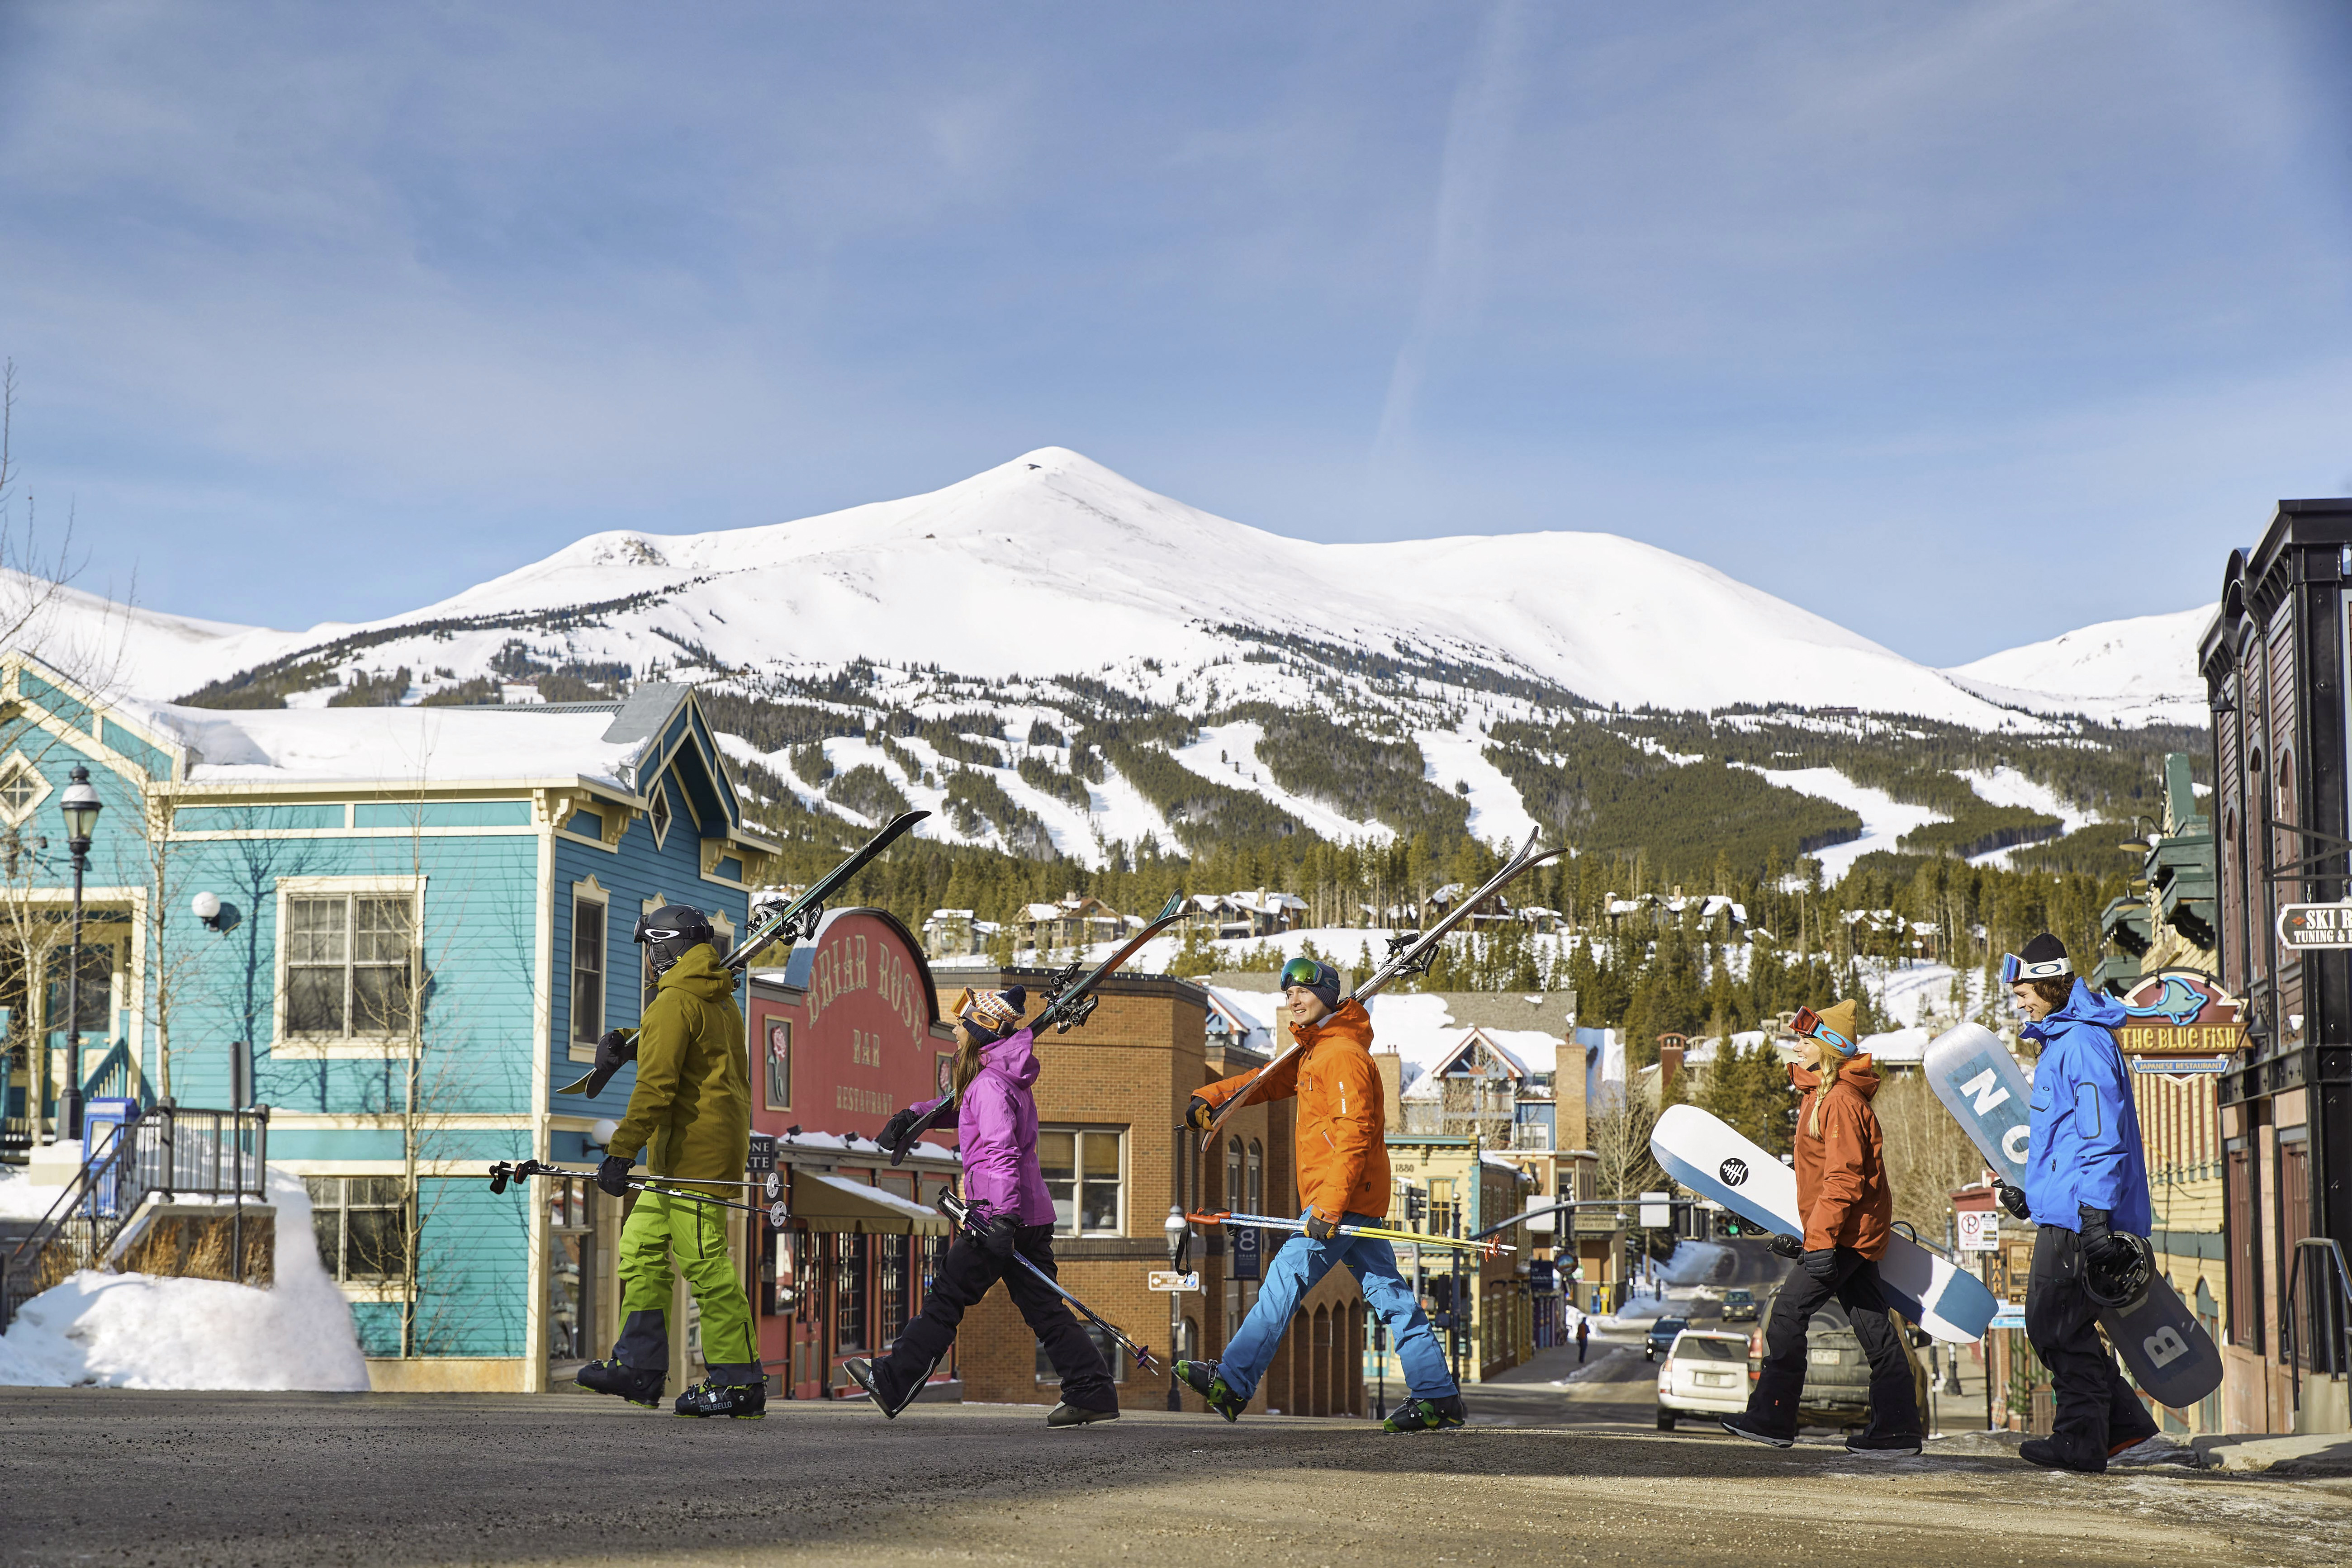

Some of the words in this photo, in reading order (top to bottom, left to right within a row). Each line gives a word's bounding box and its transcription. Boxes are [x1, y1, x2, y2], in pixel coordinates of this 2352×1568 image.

[2305, 909, 2336, 930] SKI
[2294, 930, 2334, 943] TUNING
[2337, 929, 2345, 943] &
[806, 934, 868, 1030] BRIAR
[877, 942, 926, 1052] ROSE
[853, 1028, 881, 1068] BAR
[2175, 1062, 2222, 1070] RESTAURANT
[836, 1085, 893, 1116] RESTAURANT
[749, 1142, 770, 1152] NE
[1395, 1164, 1414, 1172] 1880
[1992, 1259, 2003, 1293] BAR
[699, 1401, 733, 1412] DALBELLO
